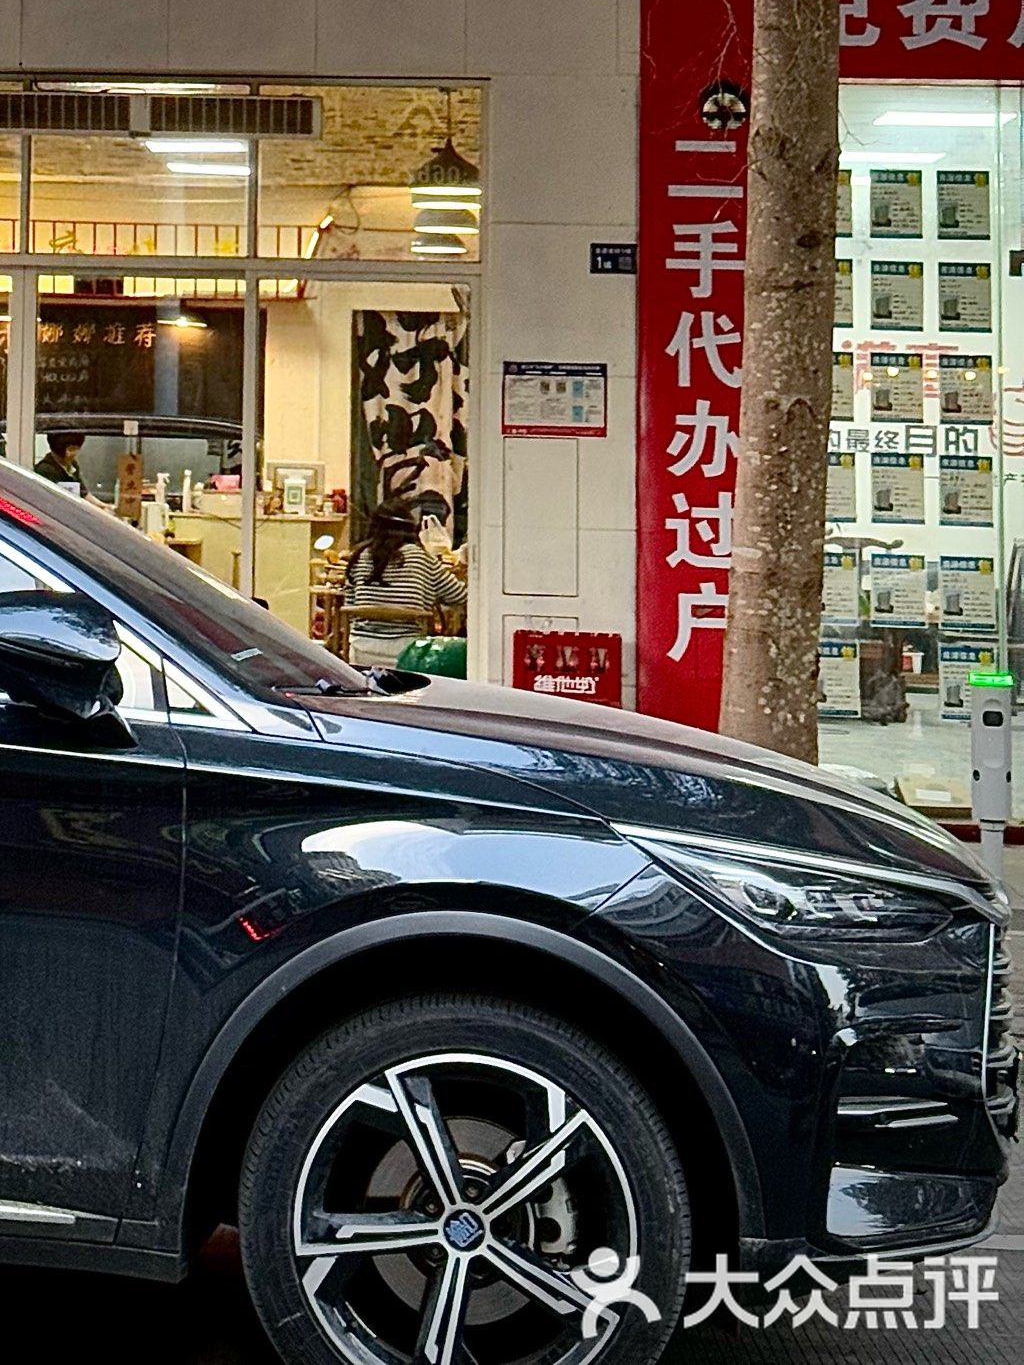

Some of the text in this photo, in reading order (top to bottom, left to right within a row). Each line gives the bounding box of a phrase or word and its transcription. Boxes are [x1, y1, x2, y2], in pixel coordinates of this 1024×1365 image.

[665, 140, 745, 663] 二手代办过户
